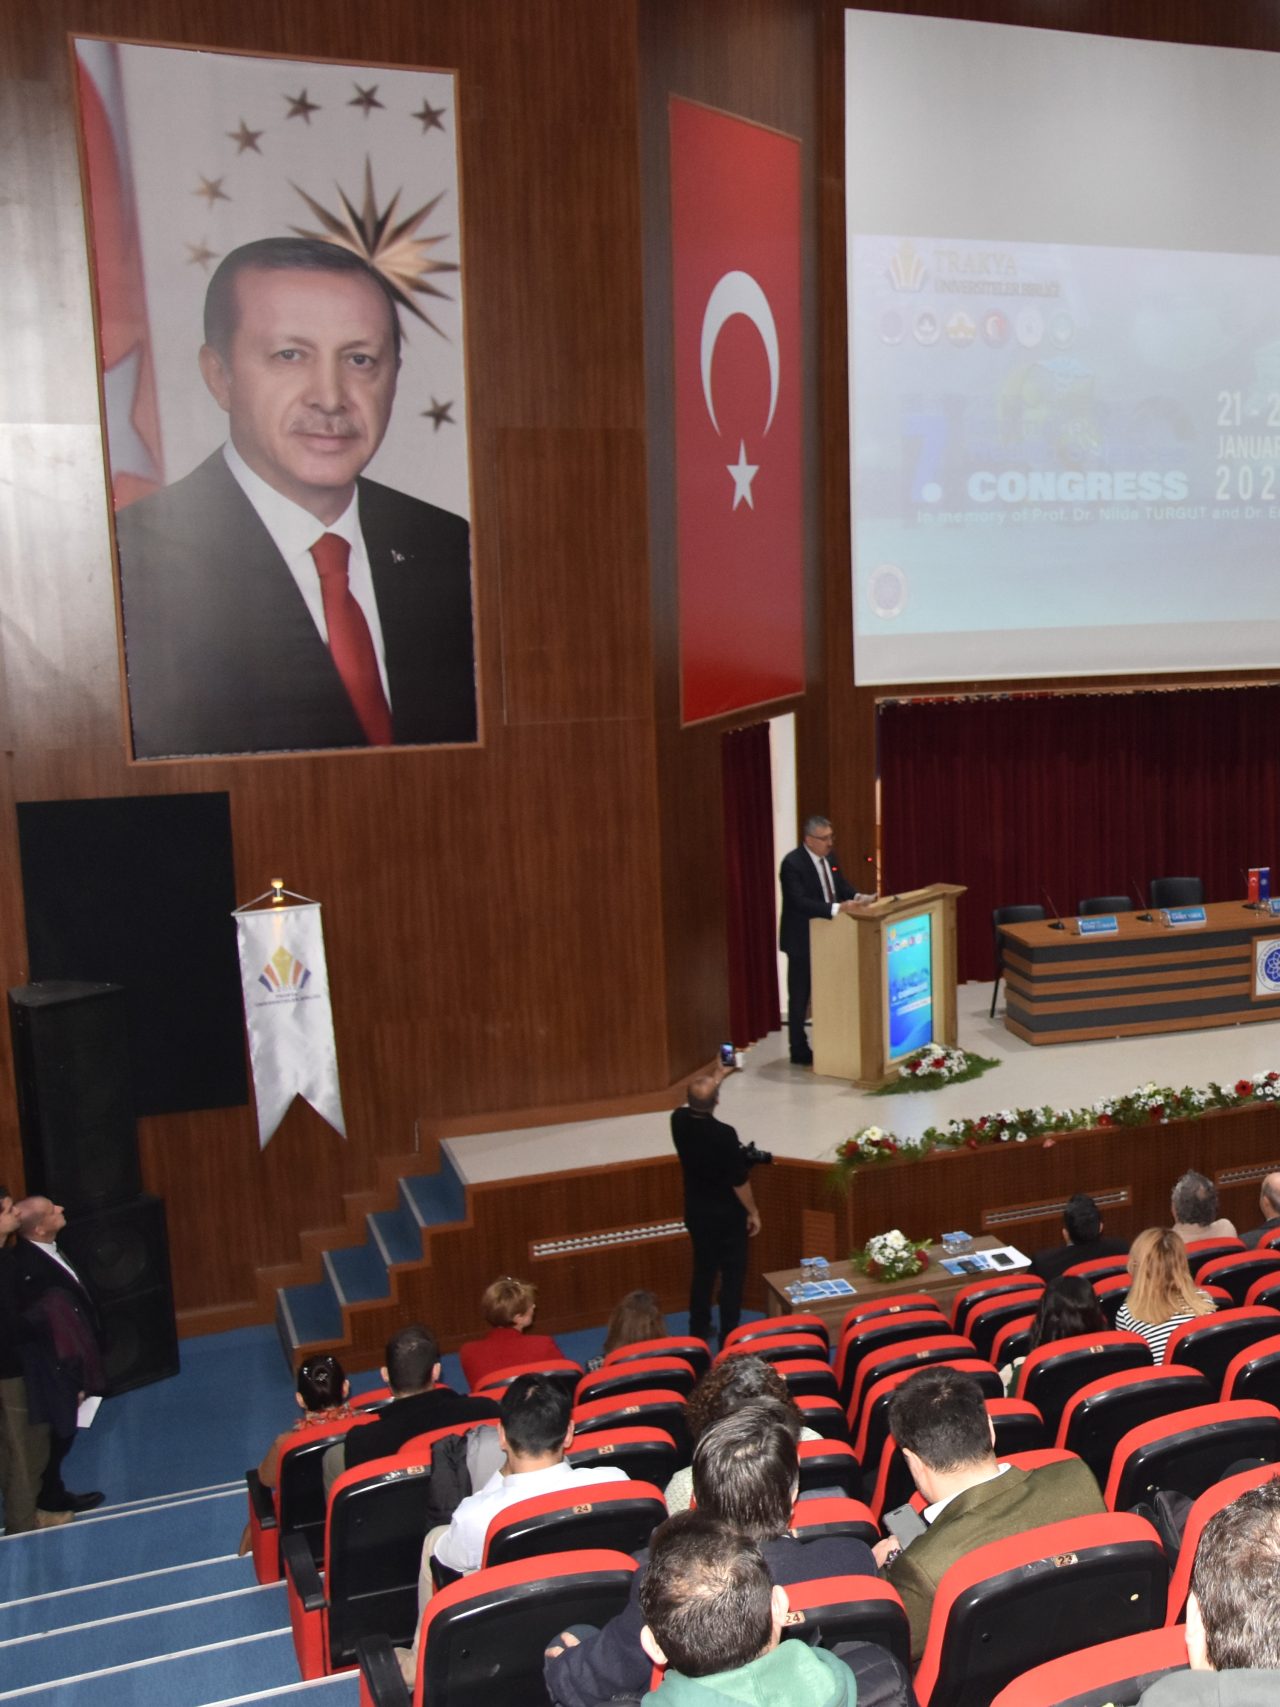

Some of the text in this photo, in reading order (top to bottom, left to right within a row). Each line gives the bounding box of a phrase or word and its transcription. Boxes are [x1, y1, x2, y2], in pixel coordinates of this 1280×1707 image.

[932, 249, 1018, 277] TRAKYA
[1216, 390, 1242, 426] 21
[967, 470, 1189, 503] CONGRESS
[938, 511, 1005, 525] memory
[1011, 508, 1029, 522] of
[1073, 508, 1096, 521] Dr.
[1145, 505, 1208, 520] TURGUT
[1212, 506, 1240, 520] and
[576, 1504, 589, 1513] 24
[785, 1613, 801, 1624] 24
